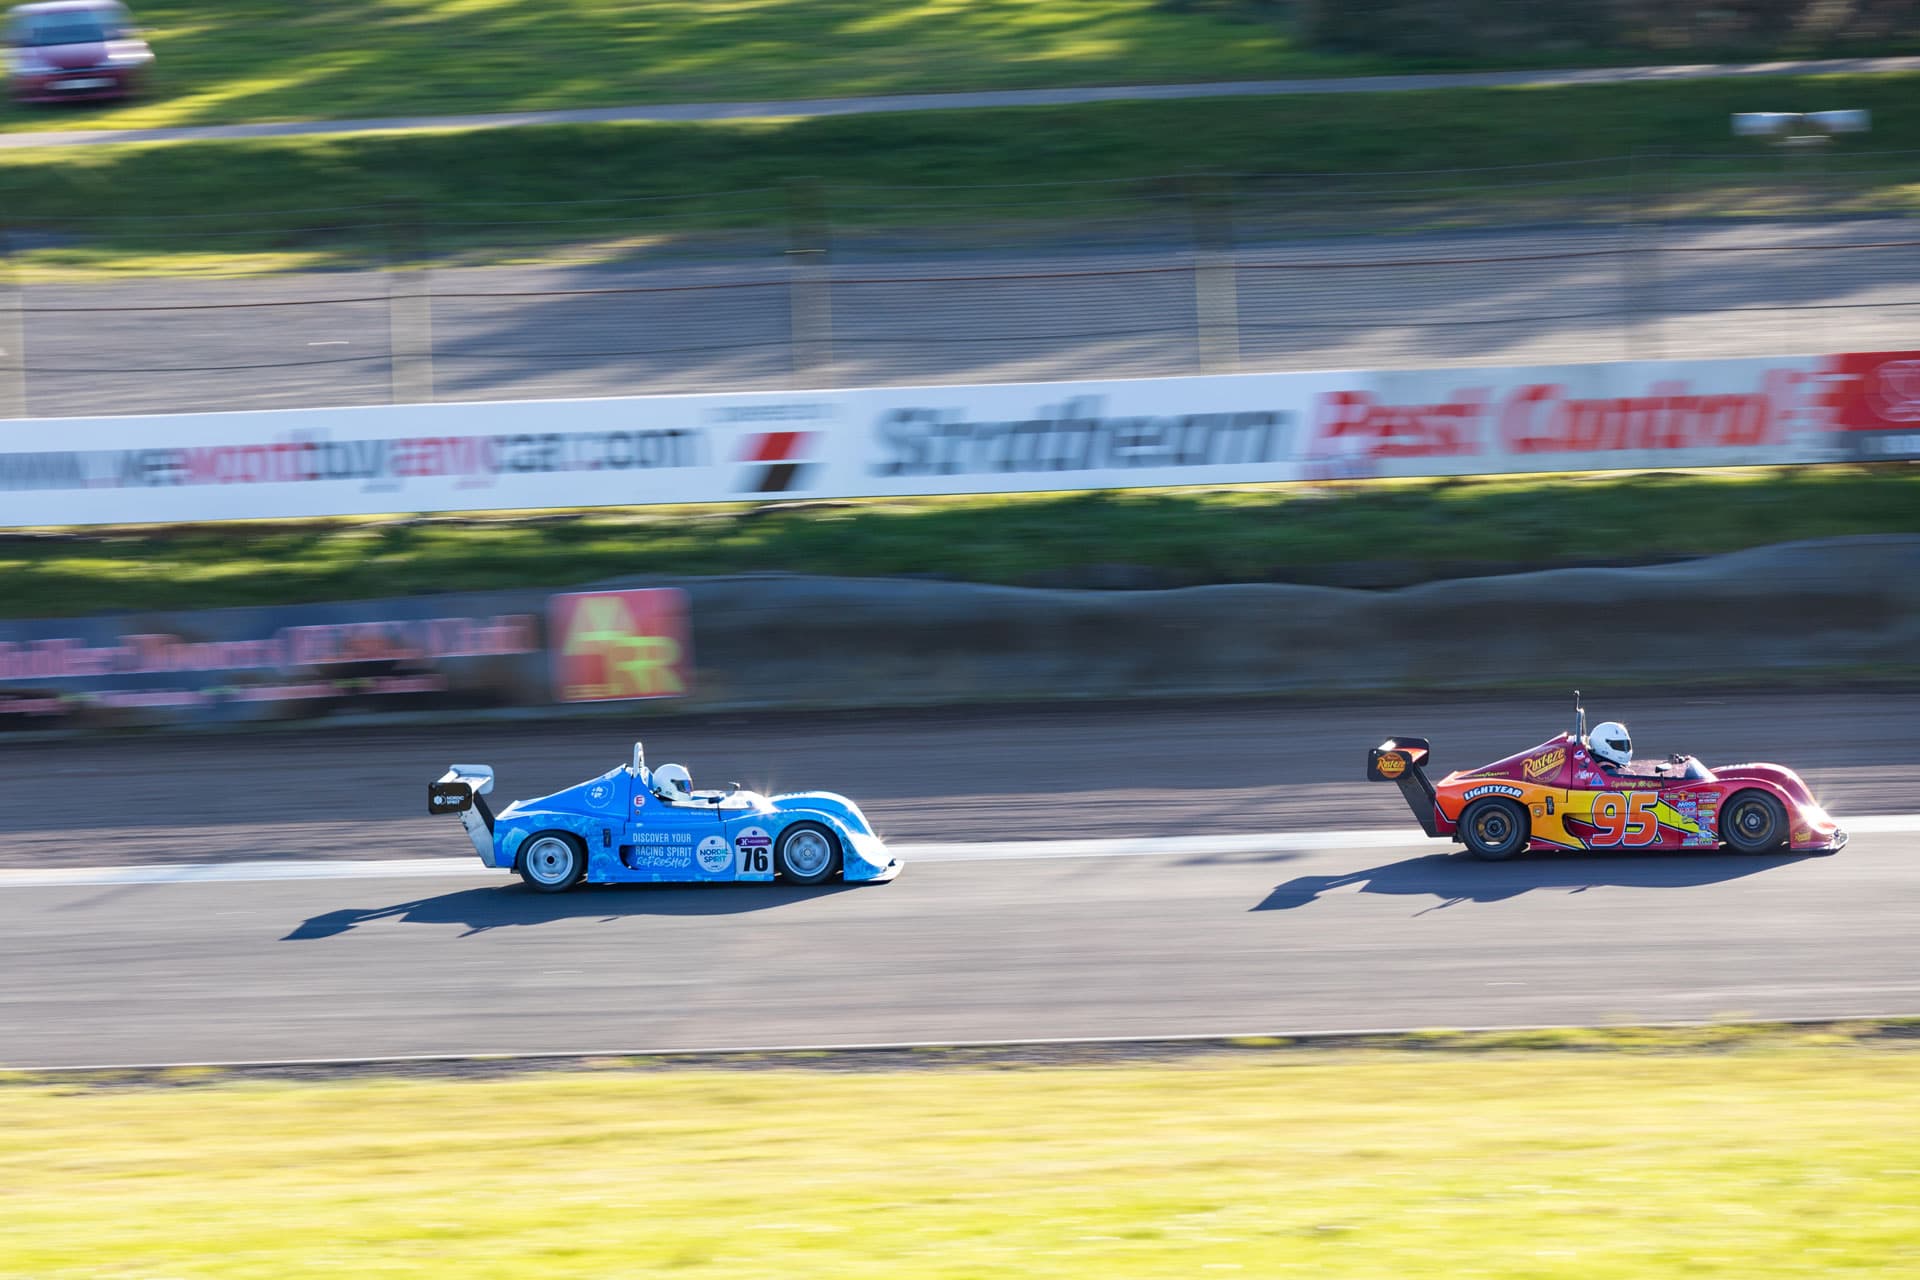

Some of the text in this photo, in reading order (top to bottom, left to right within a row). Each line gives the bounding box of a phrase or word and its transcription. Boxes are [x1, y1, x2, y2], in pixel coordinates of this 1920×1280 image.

[1464, 785, 1522, 801] LIGHTYEAR
[1590, 791, 1659, 847] 95
[632, 833, 692, 843] DISCOVER YOUR
[635, 846, 692, 857] RACING SPIRIT
[699, 848, 728, 856] NORDIC
[703, 855, 727, 863] SPIRIT
[741, 847, 769, 872] 76
